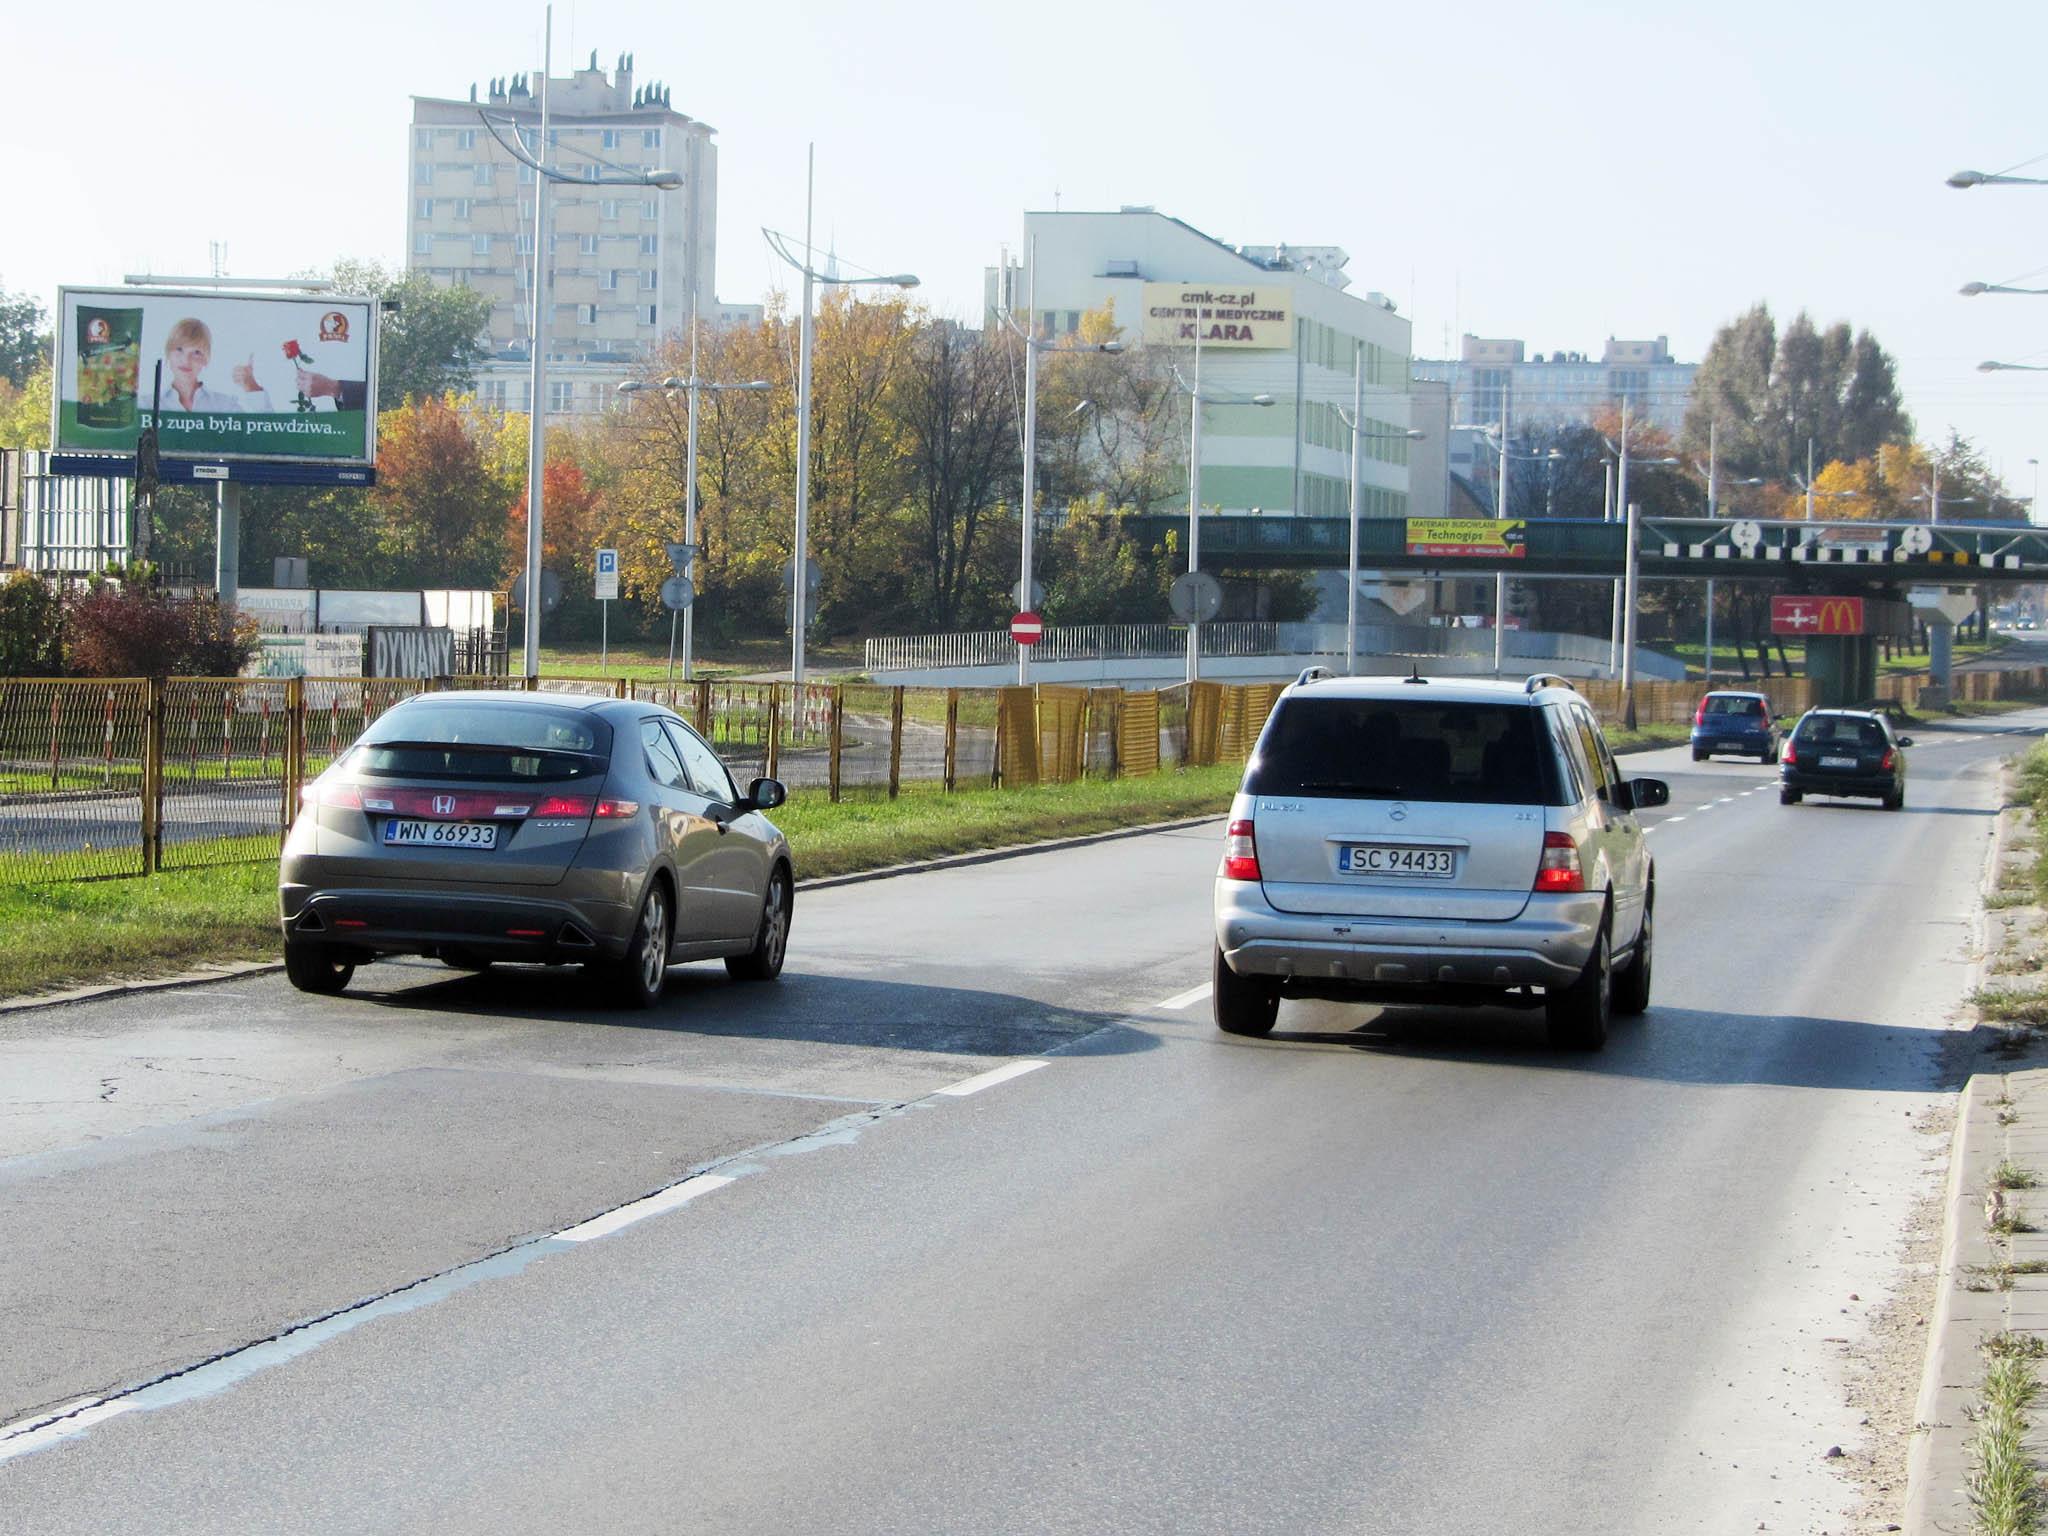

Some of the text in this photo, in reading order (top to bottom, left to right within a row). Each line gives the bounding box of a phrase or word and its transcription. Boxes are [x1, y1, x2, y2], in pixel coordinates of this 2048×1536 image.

[1181, 290, 1255, 308] cmk-cz.pl
[1150, 307, 1285, 321] CENTRUM MEDYCZNE
[167, 417, 205, 433] zupa
[209, 416, 242, 434] była
[246, 417, 346, 435] prawdziwa...
[1427, 529, 1483, 542] Technogips
[375, 631, 452, 678] DYWANY
[400, 823, 494, 844] WN 66933
[1353, 850, 1451, 871] SC 94433
